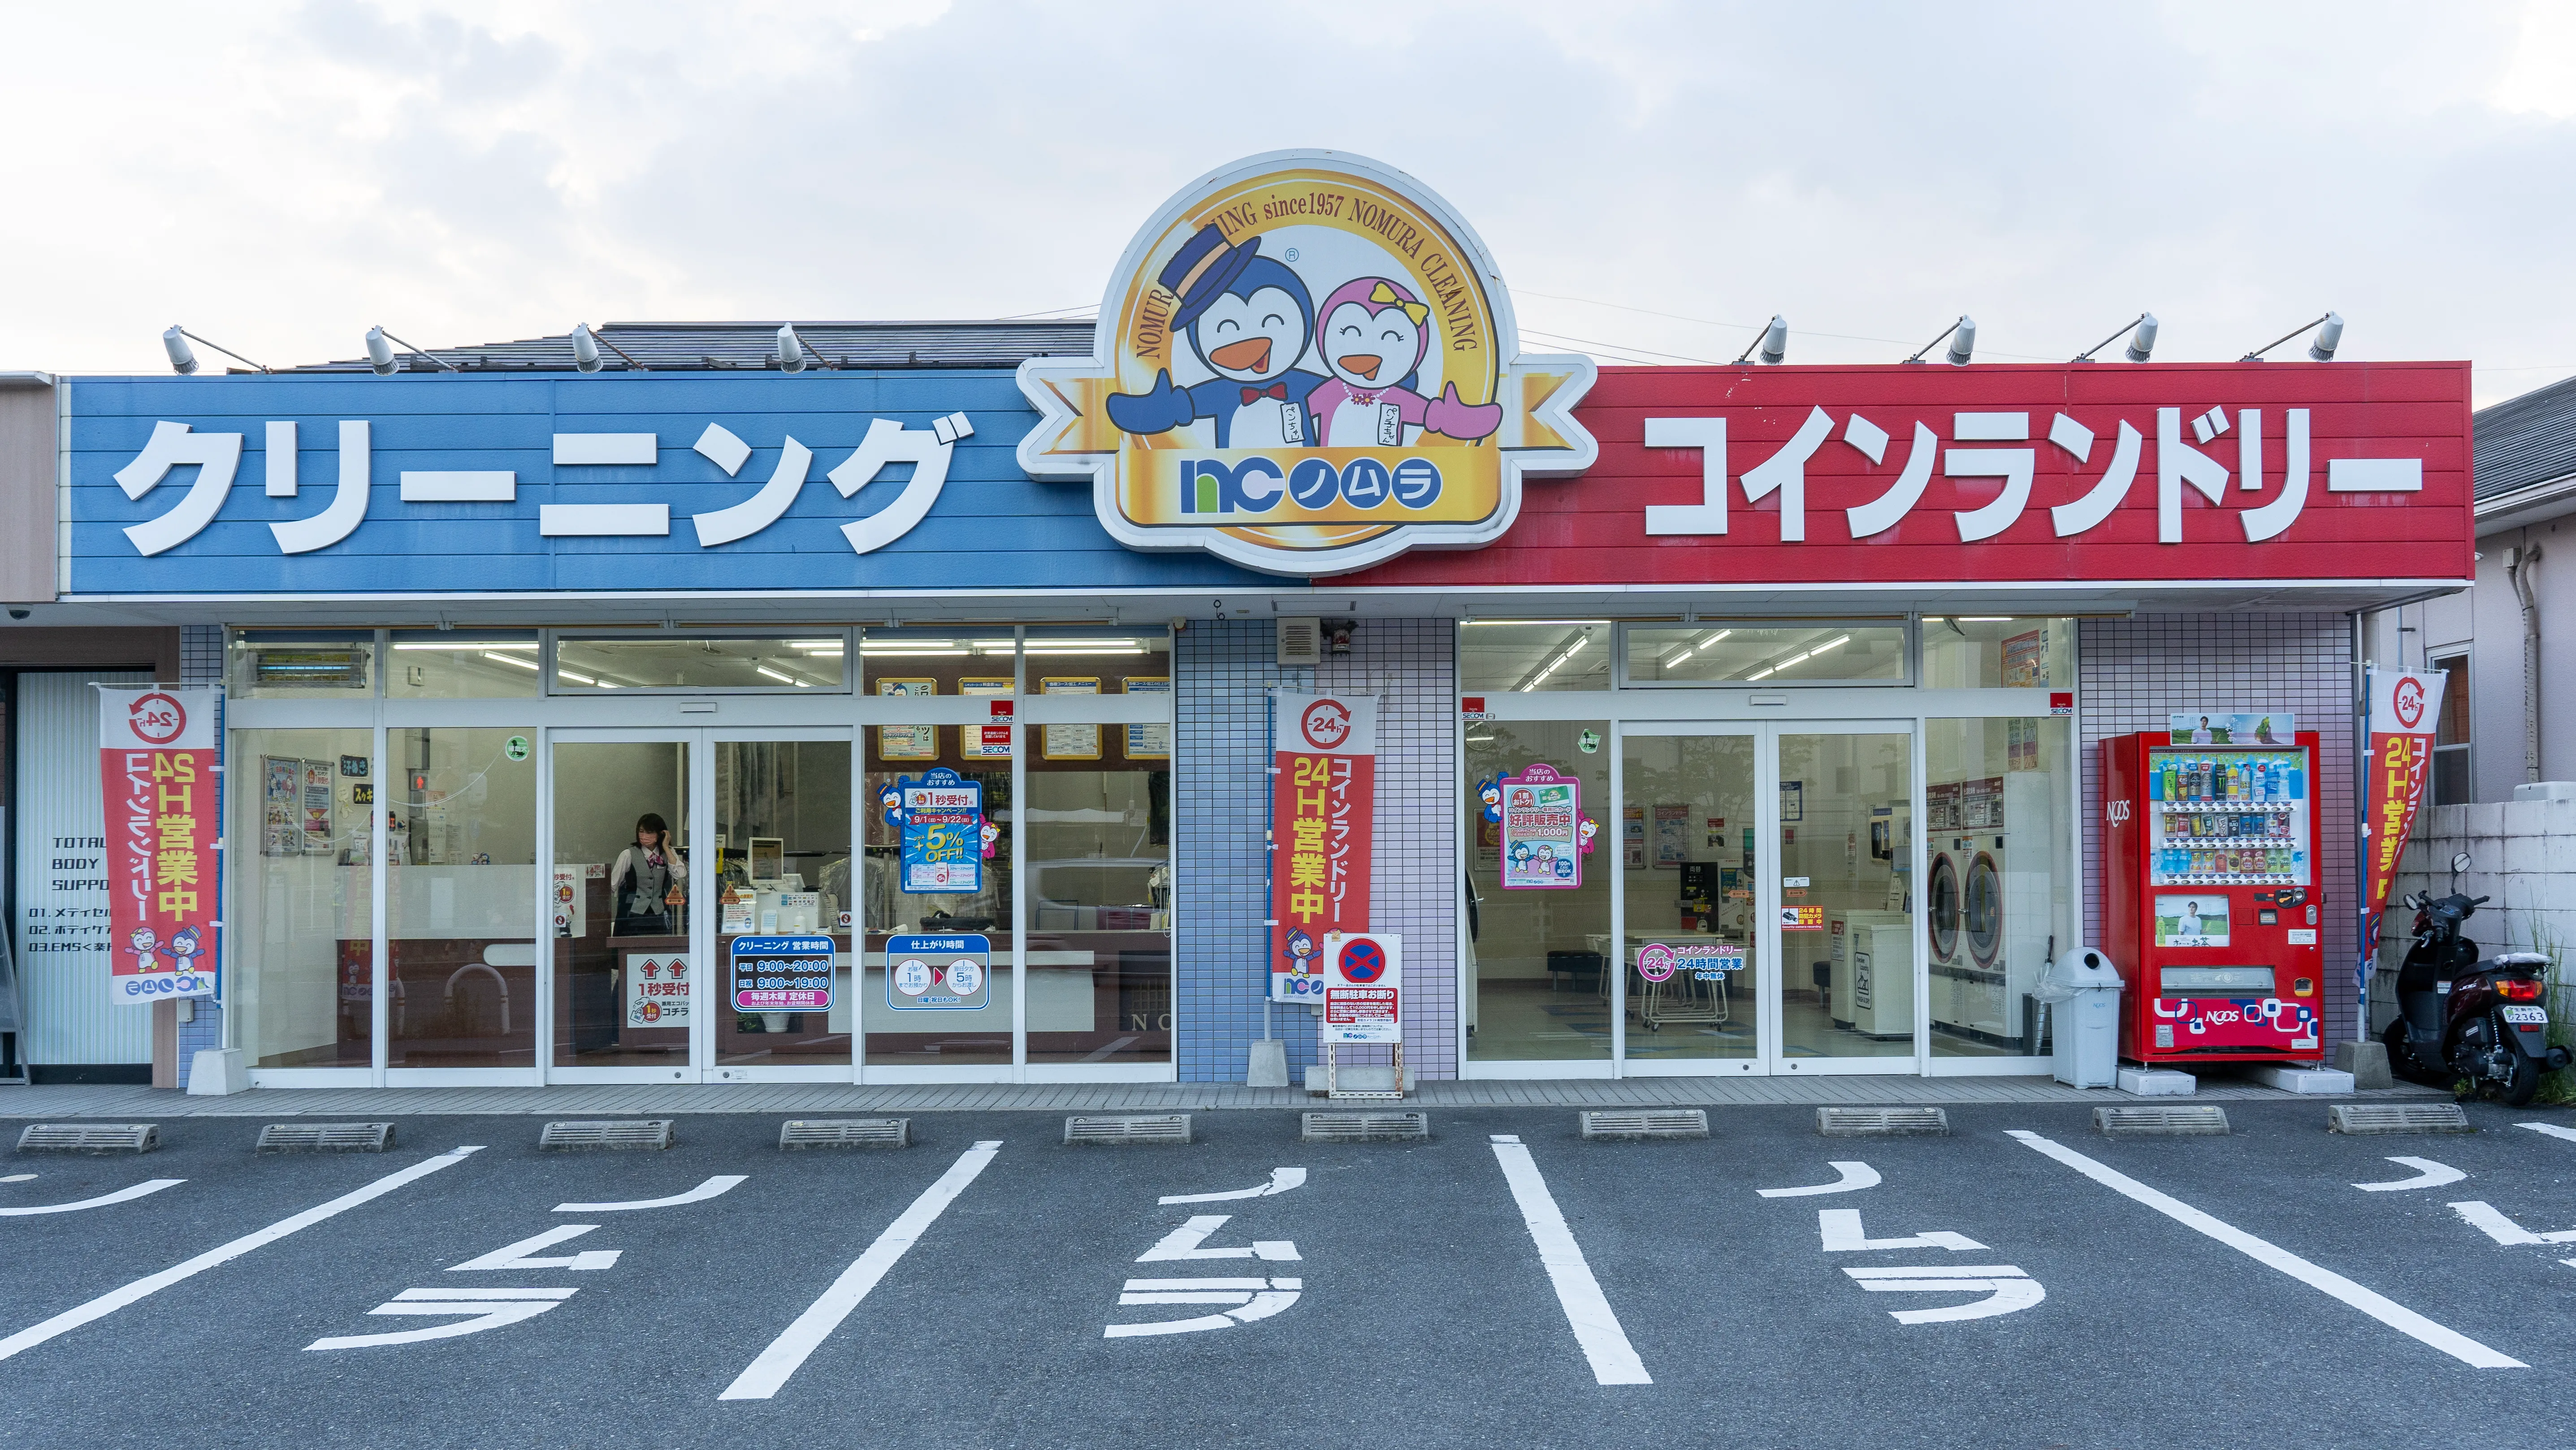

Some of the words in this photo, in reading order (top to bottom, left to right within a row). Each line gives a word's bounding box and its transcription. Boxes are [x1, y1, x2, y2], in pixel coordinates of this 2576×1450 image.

[1347, 197, 1422, 259] NOMURA
[1421, 252, 1478, 353] CLEANING
[1645, 404, 2422, 543] コインランドリー
[113, 410, 975, 557] クリーニング
[1509, 813, 1572, 827] 好評販売中
[1537, 828, 1568, 837] 1,000円
[53, 837, 107, 848] TOTAL
[1290, 757, 1331, 924] 24H営業中
[1330, 758, 1352, 922] コインランドリー
[52, 859, 99, 869] BODY
[52, 880, 109, 890] SUPPO
[738, 941, 789, 951] クリーニング
[792, 941, 829, 950] 営業時間
[911, 940, 964, 949] 仕上がり時間
[1677, 946, 1743, 955] コインランドリー
[739, 963, 753, 972] 平日
[1676, 957, 1743, 970] 24時間営業
[907, 972, 921, 982] 1時
[956, 972, 972, 982] 5時
[1695, 972, 1725, 981] 年中無休
[639, 982, 690, 996] 1秒受付
[739, 980, 753, 988] 日祝
[751, 992, 787, 1001] 毎週木曜
[789, 992, 815, 1000] 定休日
[1330, 990, 1394, 999] 無断駐車お断り
[662, 1007, 689, 1016] コチラ
[2515, 1012, 2544, 1021] 2363
[2205, 1011, 2239, 1025] NOOS
